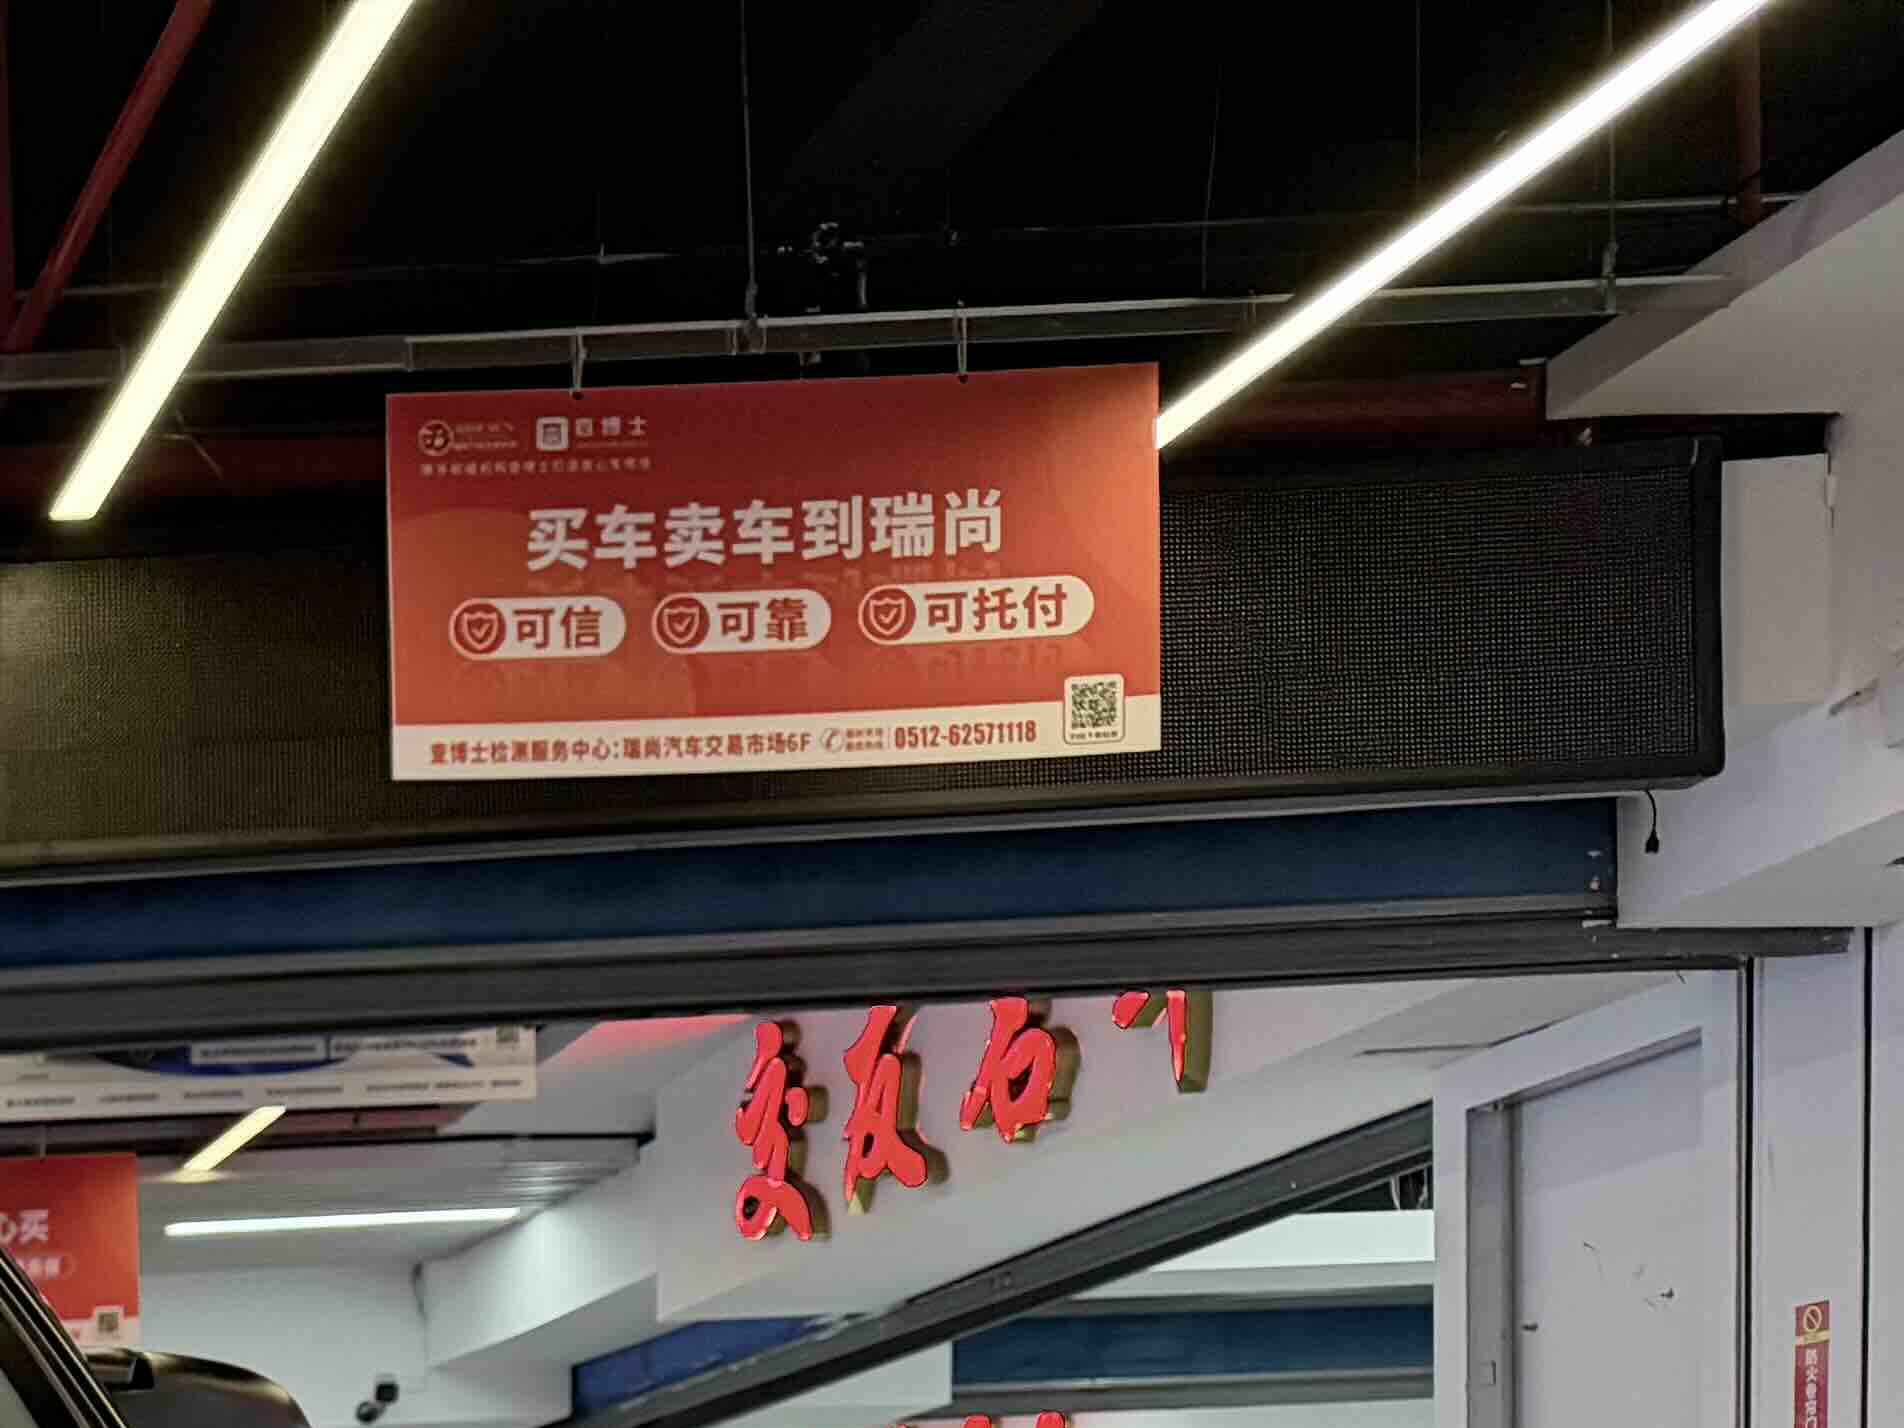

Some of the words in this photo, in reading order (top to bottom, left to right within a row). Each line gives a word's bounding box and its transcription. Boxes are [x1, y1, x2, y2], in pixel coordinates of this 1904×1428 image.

[526, 488, 1004, 572] 买车卖车到瑞尚
[515, 605, 604, 648] 可信
[719, 598, 811, 642] 可靠
[926, 585, 1069, 634] 可托付
[894, 720, 1038, 751] 0512-62571118
